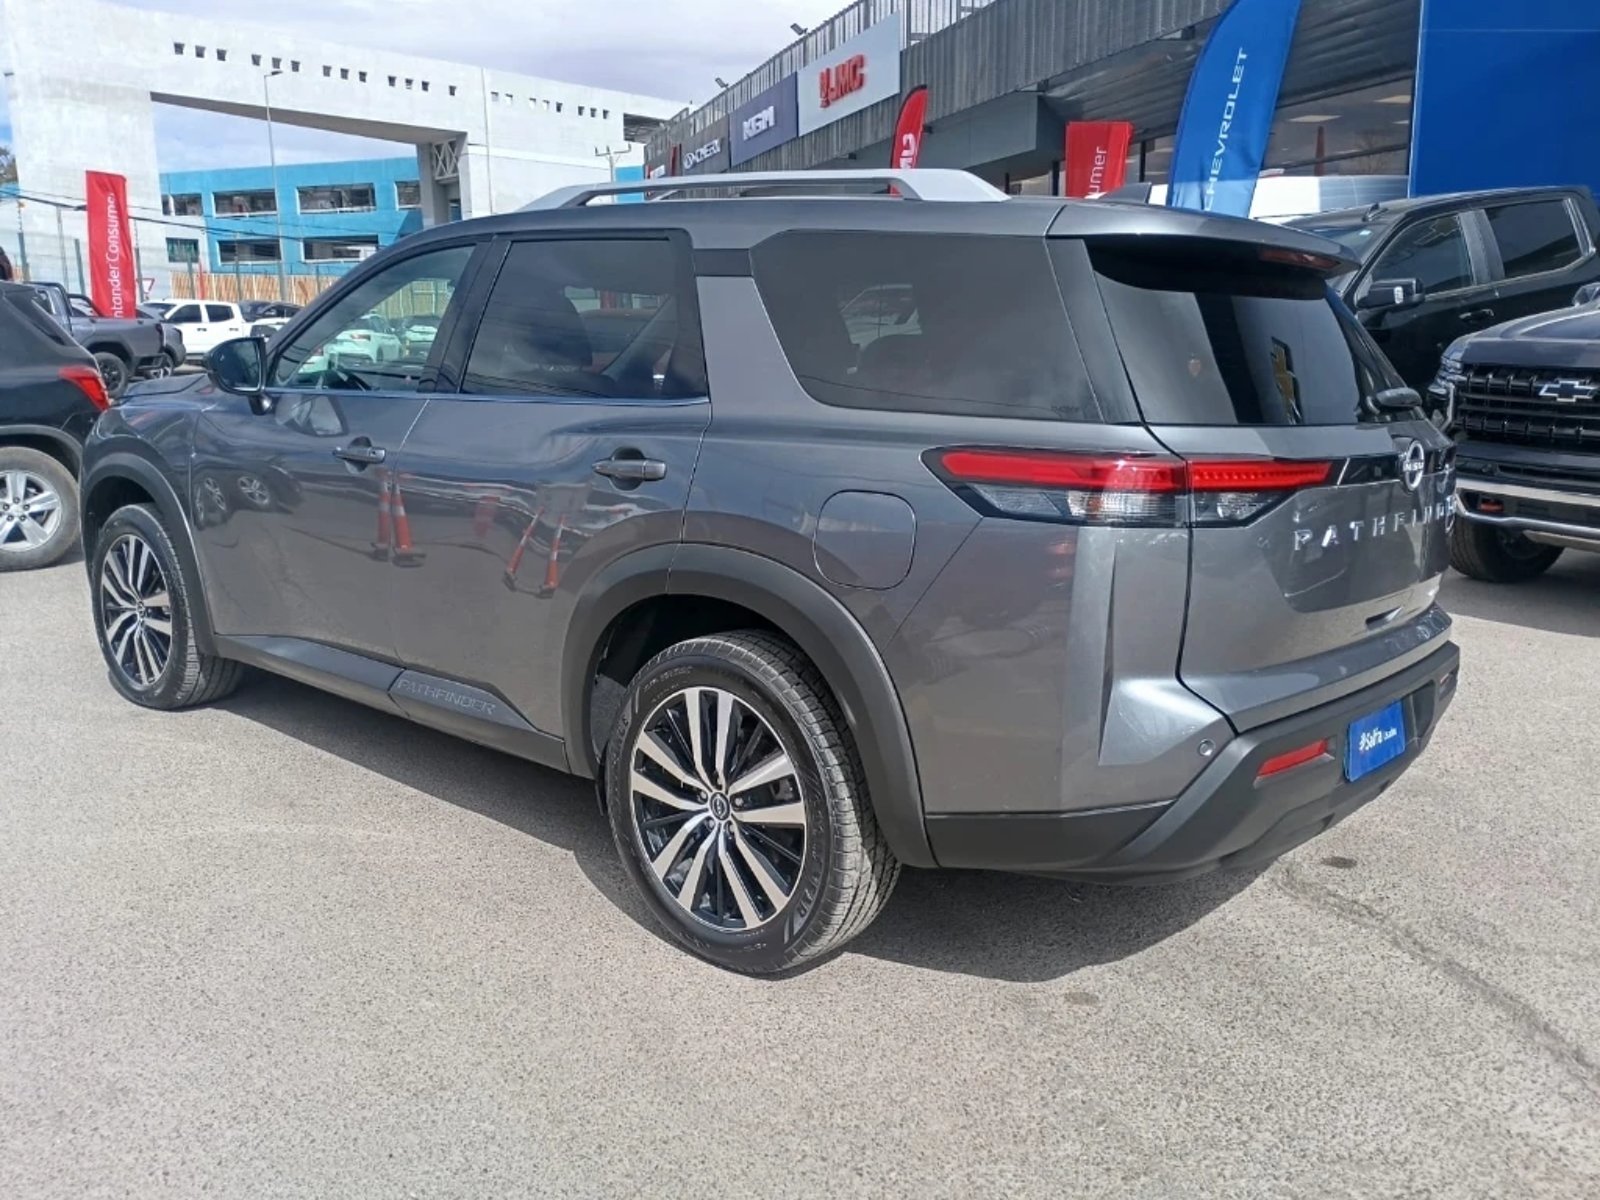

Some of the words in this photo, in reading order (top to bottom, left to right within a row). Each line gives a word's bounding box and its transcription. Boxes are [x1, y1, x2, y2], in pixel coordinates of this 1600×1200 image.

[742, 105, 775, 140] KGM
[1204, 47, 1248, 212] CHEVROLET
[1088, 146, 1107, 194] umer
[107, 264, 124, 319] ntander
[396, 679, 496, 714] PATHFINDER
